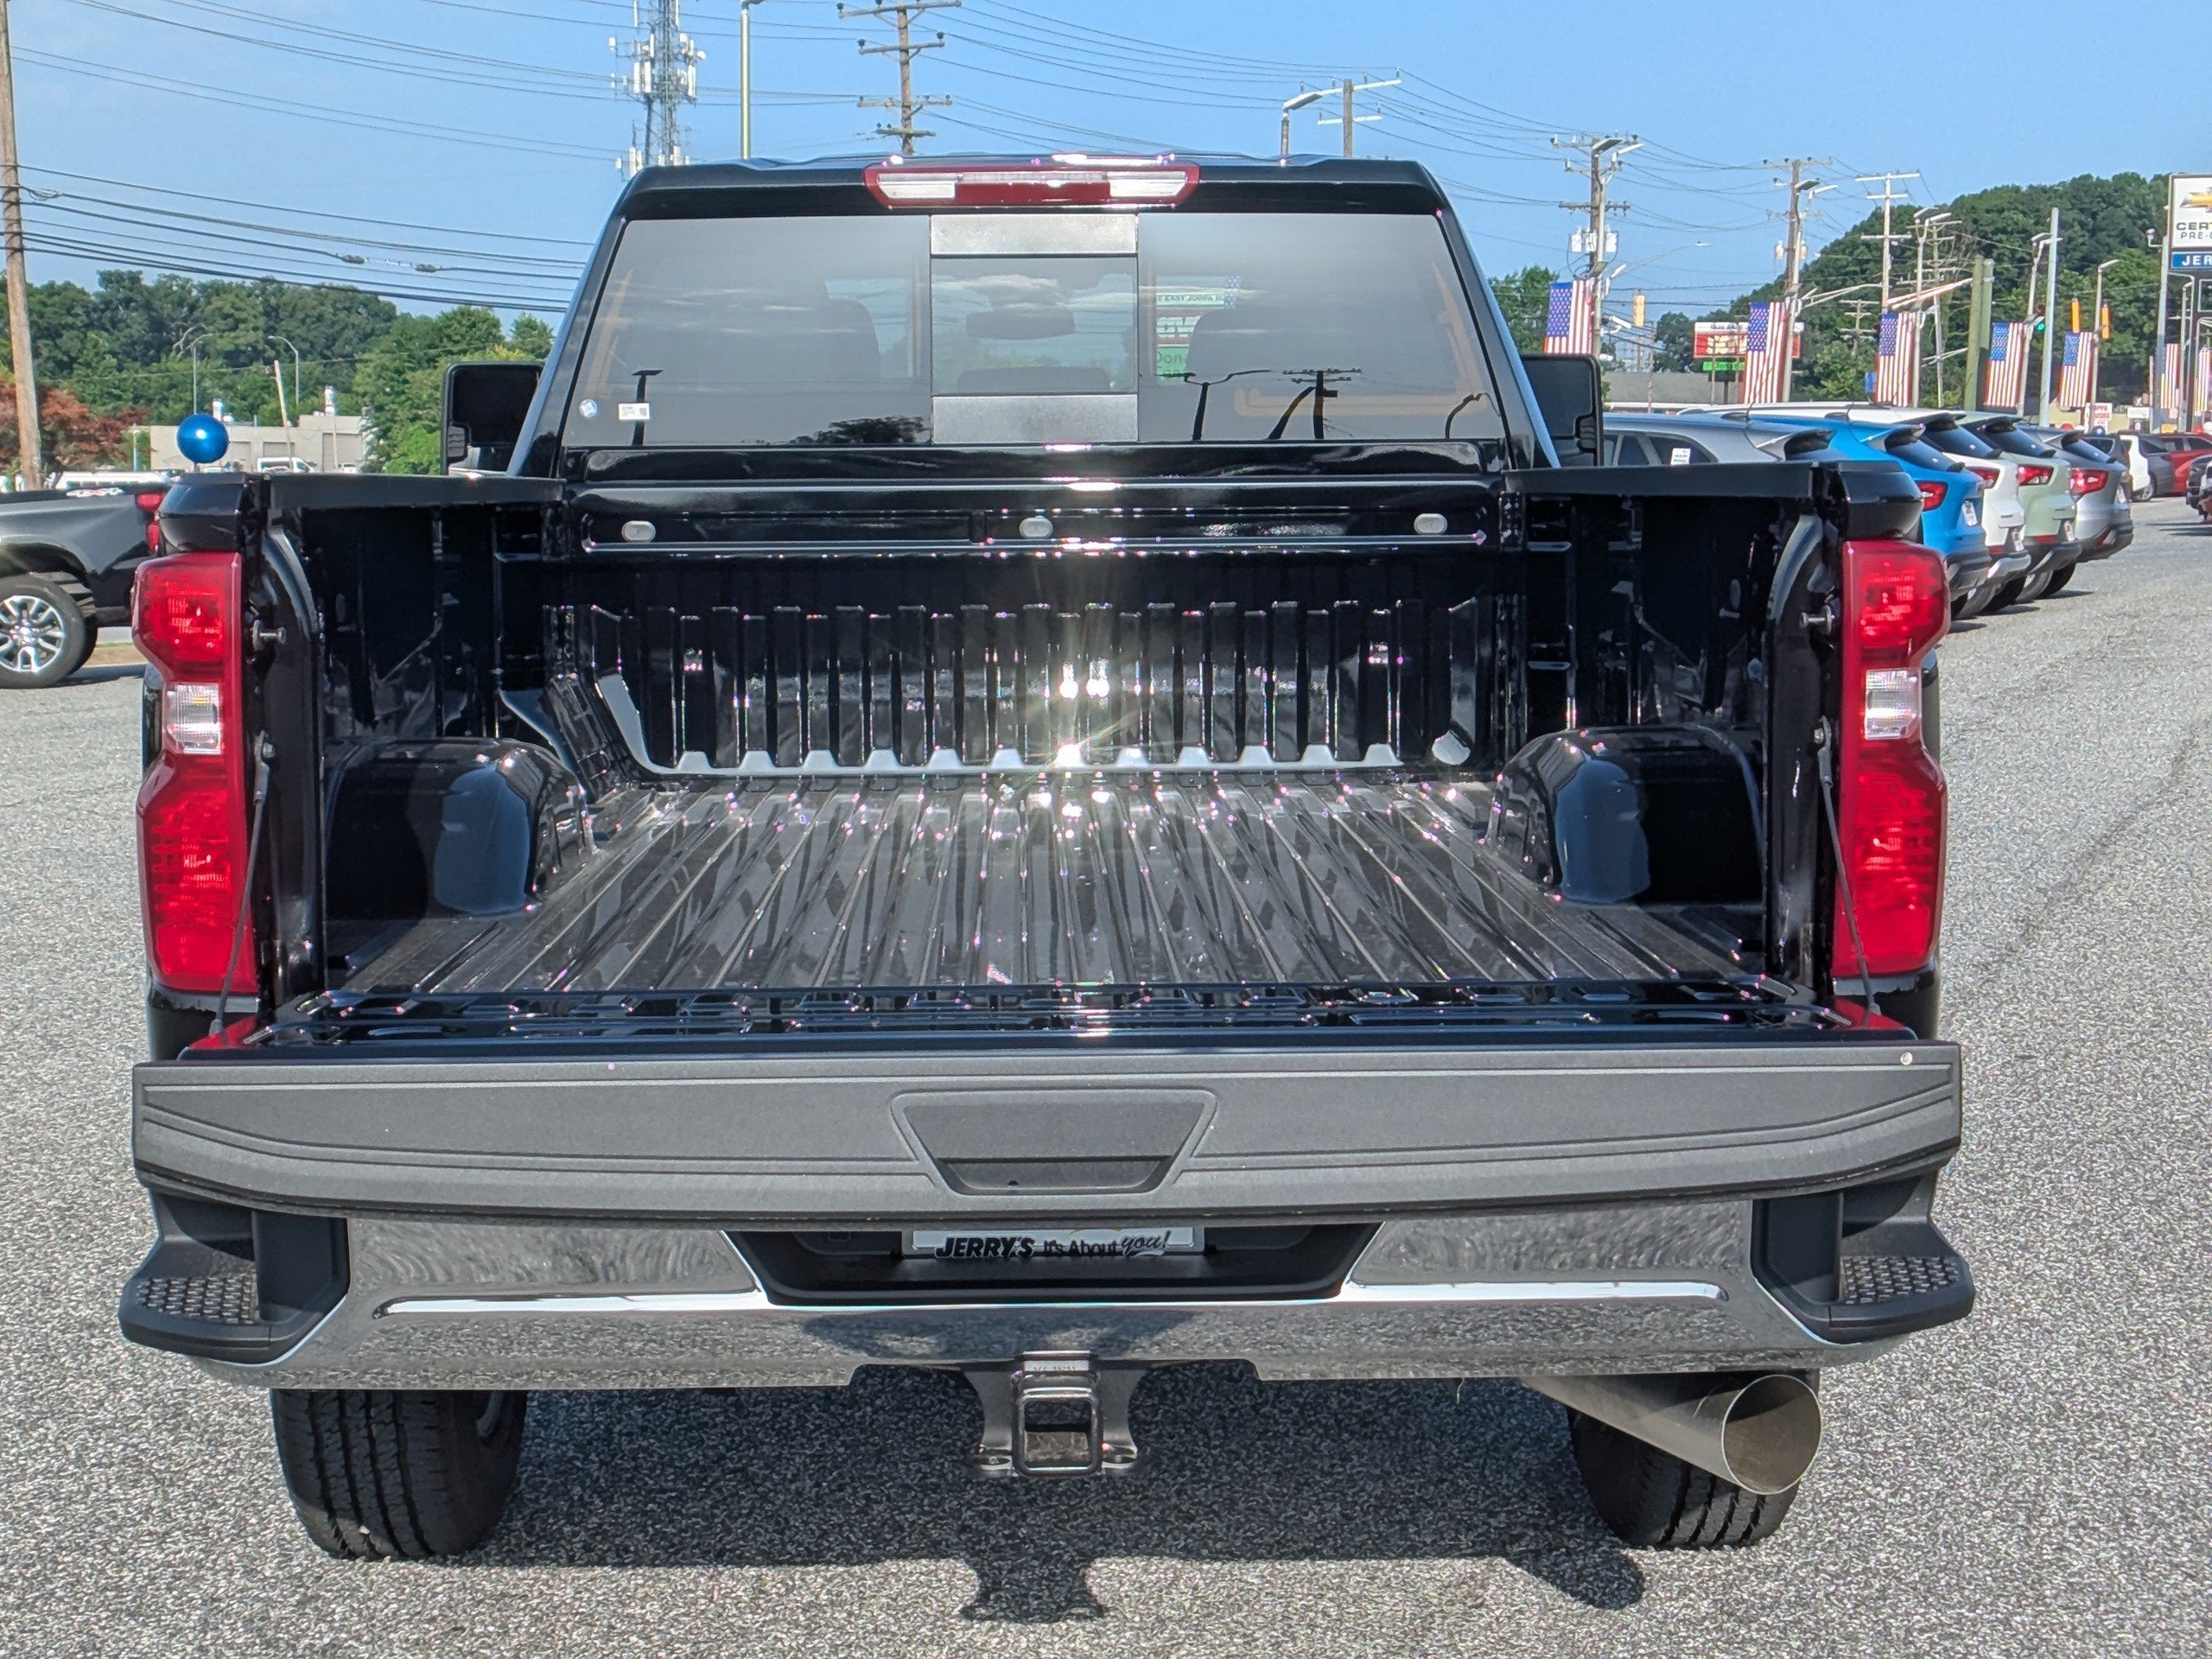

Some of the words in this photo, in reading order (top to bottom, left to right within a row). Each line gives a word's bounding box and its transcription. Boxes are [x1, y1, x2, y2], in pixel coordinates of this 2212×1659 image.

[935, 1236, 1035, 1258] JERRY'S
[1043, 1239, 1065, 1255] It's
[1068, 1239, 1120, 1255] About
[1121, 1230, 1172, 1255] you!
